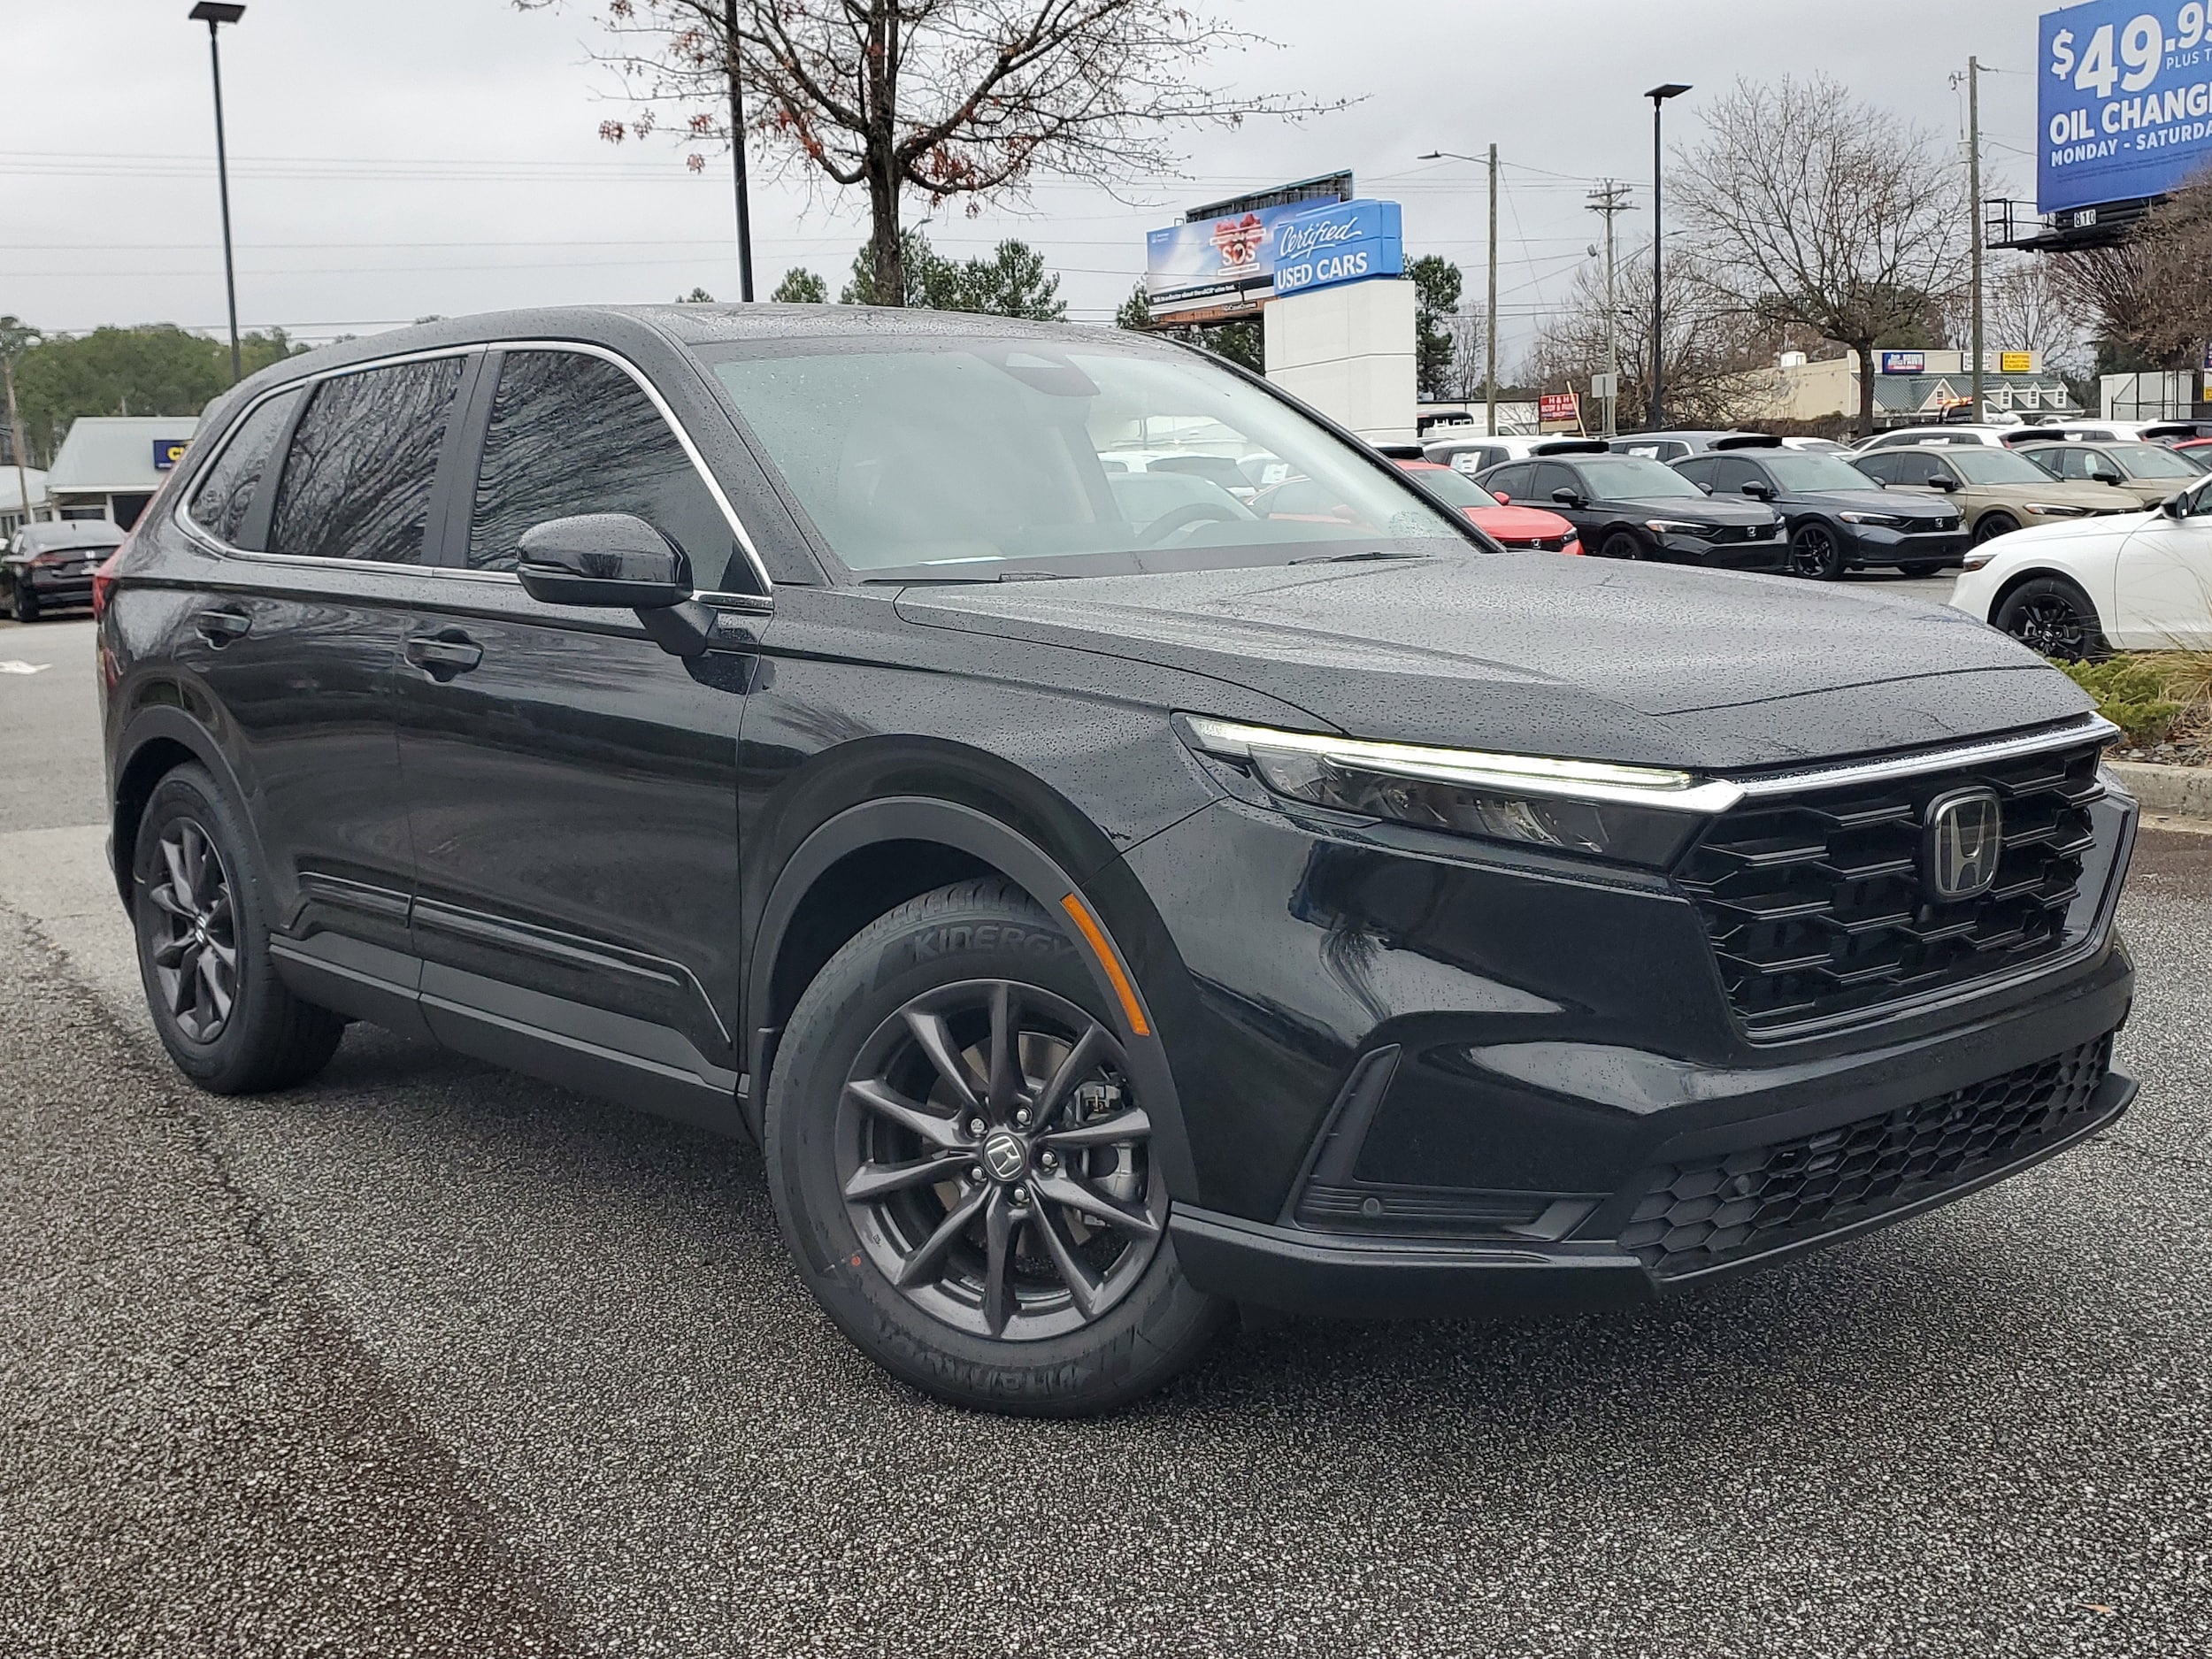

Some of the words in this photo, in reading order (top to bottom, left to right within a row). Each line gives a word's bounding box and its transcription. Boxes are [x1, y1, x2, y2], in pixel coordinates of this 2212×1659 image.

[2167, 51, 2199, 70] PLUS
[2049, 109, 2095, 145] OIL
[2101, 81, 2212, 134] CHANG
[2051, 139, 2118, 166] MONDAY
[2075, 211, 2095, 227] 810
[1280, 217, 1362, 258] Certified
[1223, 241, 1256, 265] SOS
[1277, 264, 1313, 289] USED
[1317, 252, 1368, 280] CARS
